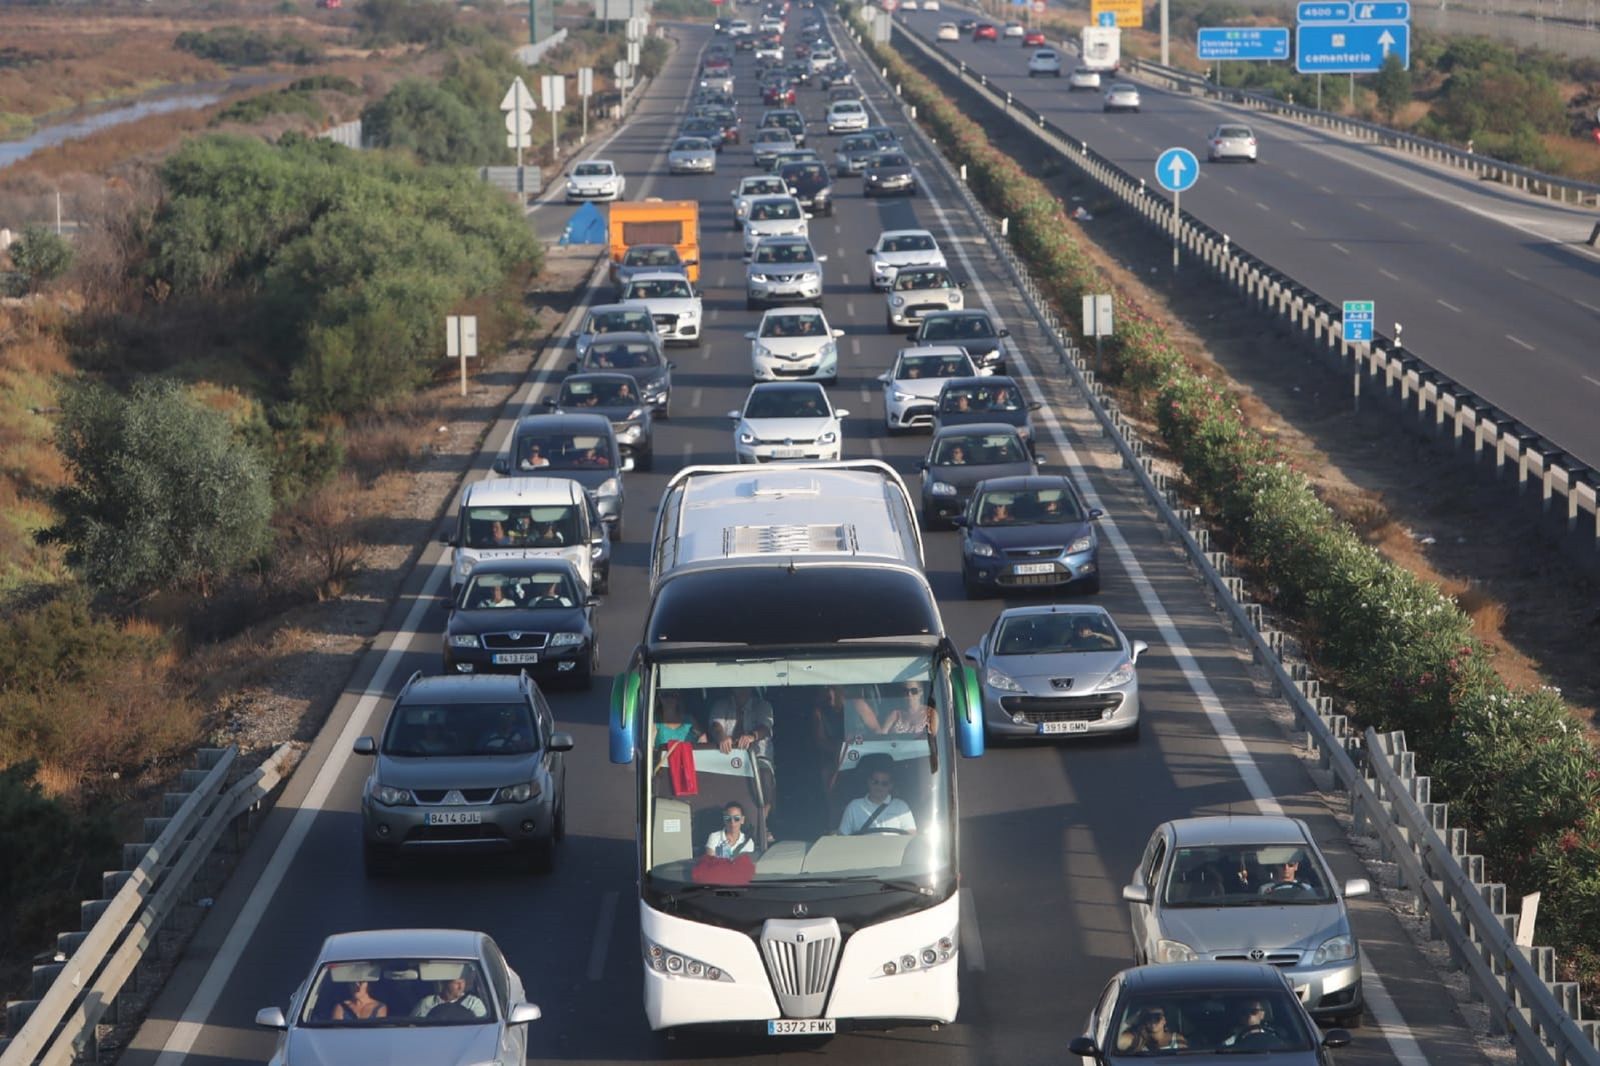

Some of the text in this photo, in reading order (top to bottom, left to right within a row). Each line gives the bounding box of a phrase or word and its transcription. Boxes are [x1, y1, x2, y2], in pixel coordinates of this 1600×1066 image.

[1304, 52, 1371, 63] cementerio
[1354, 329, 1362, 339] 2
[1045, 722, 1087, 732] 3919 GMN
[431, 813, 479, 824] 8414 GJL
[776, 1020, 832, 1033] 3372 FMK
